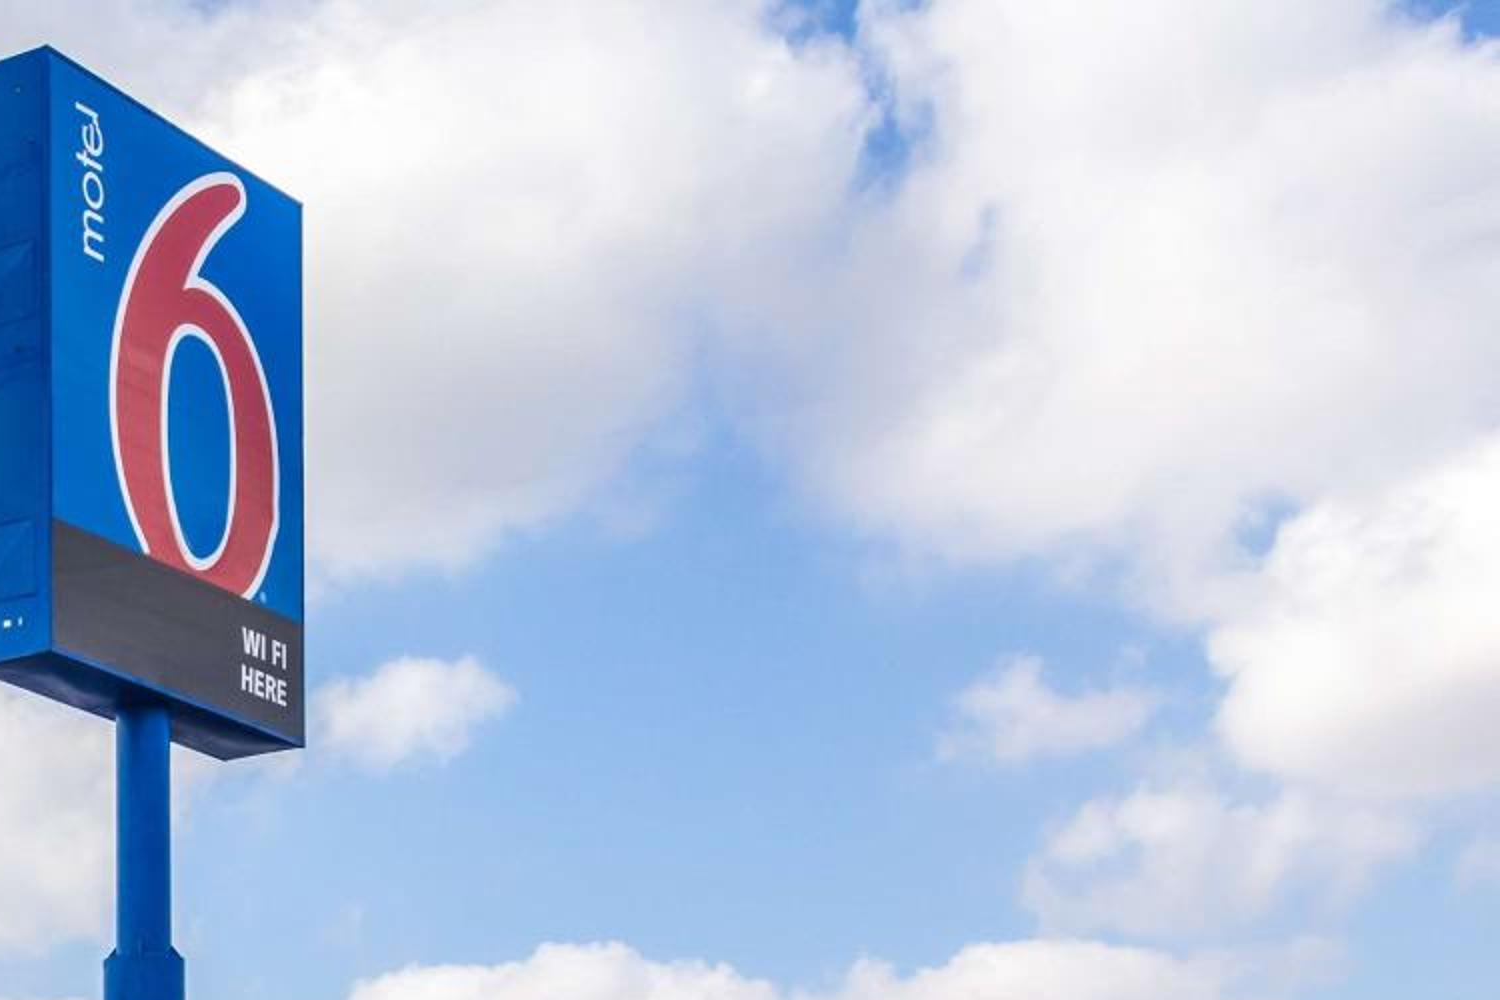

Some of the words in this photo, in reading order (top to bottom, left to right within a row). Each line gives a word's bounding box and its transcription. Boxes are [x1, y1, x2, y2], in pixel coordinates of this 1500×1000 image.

[75, 101, 105, 263] motel
[109, 171, 280, 600] 6
[241, 626, 266, 661] WI
[271, 639, 287, 670] FI
[241, 663, 288, 707] HERE
